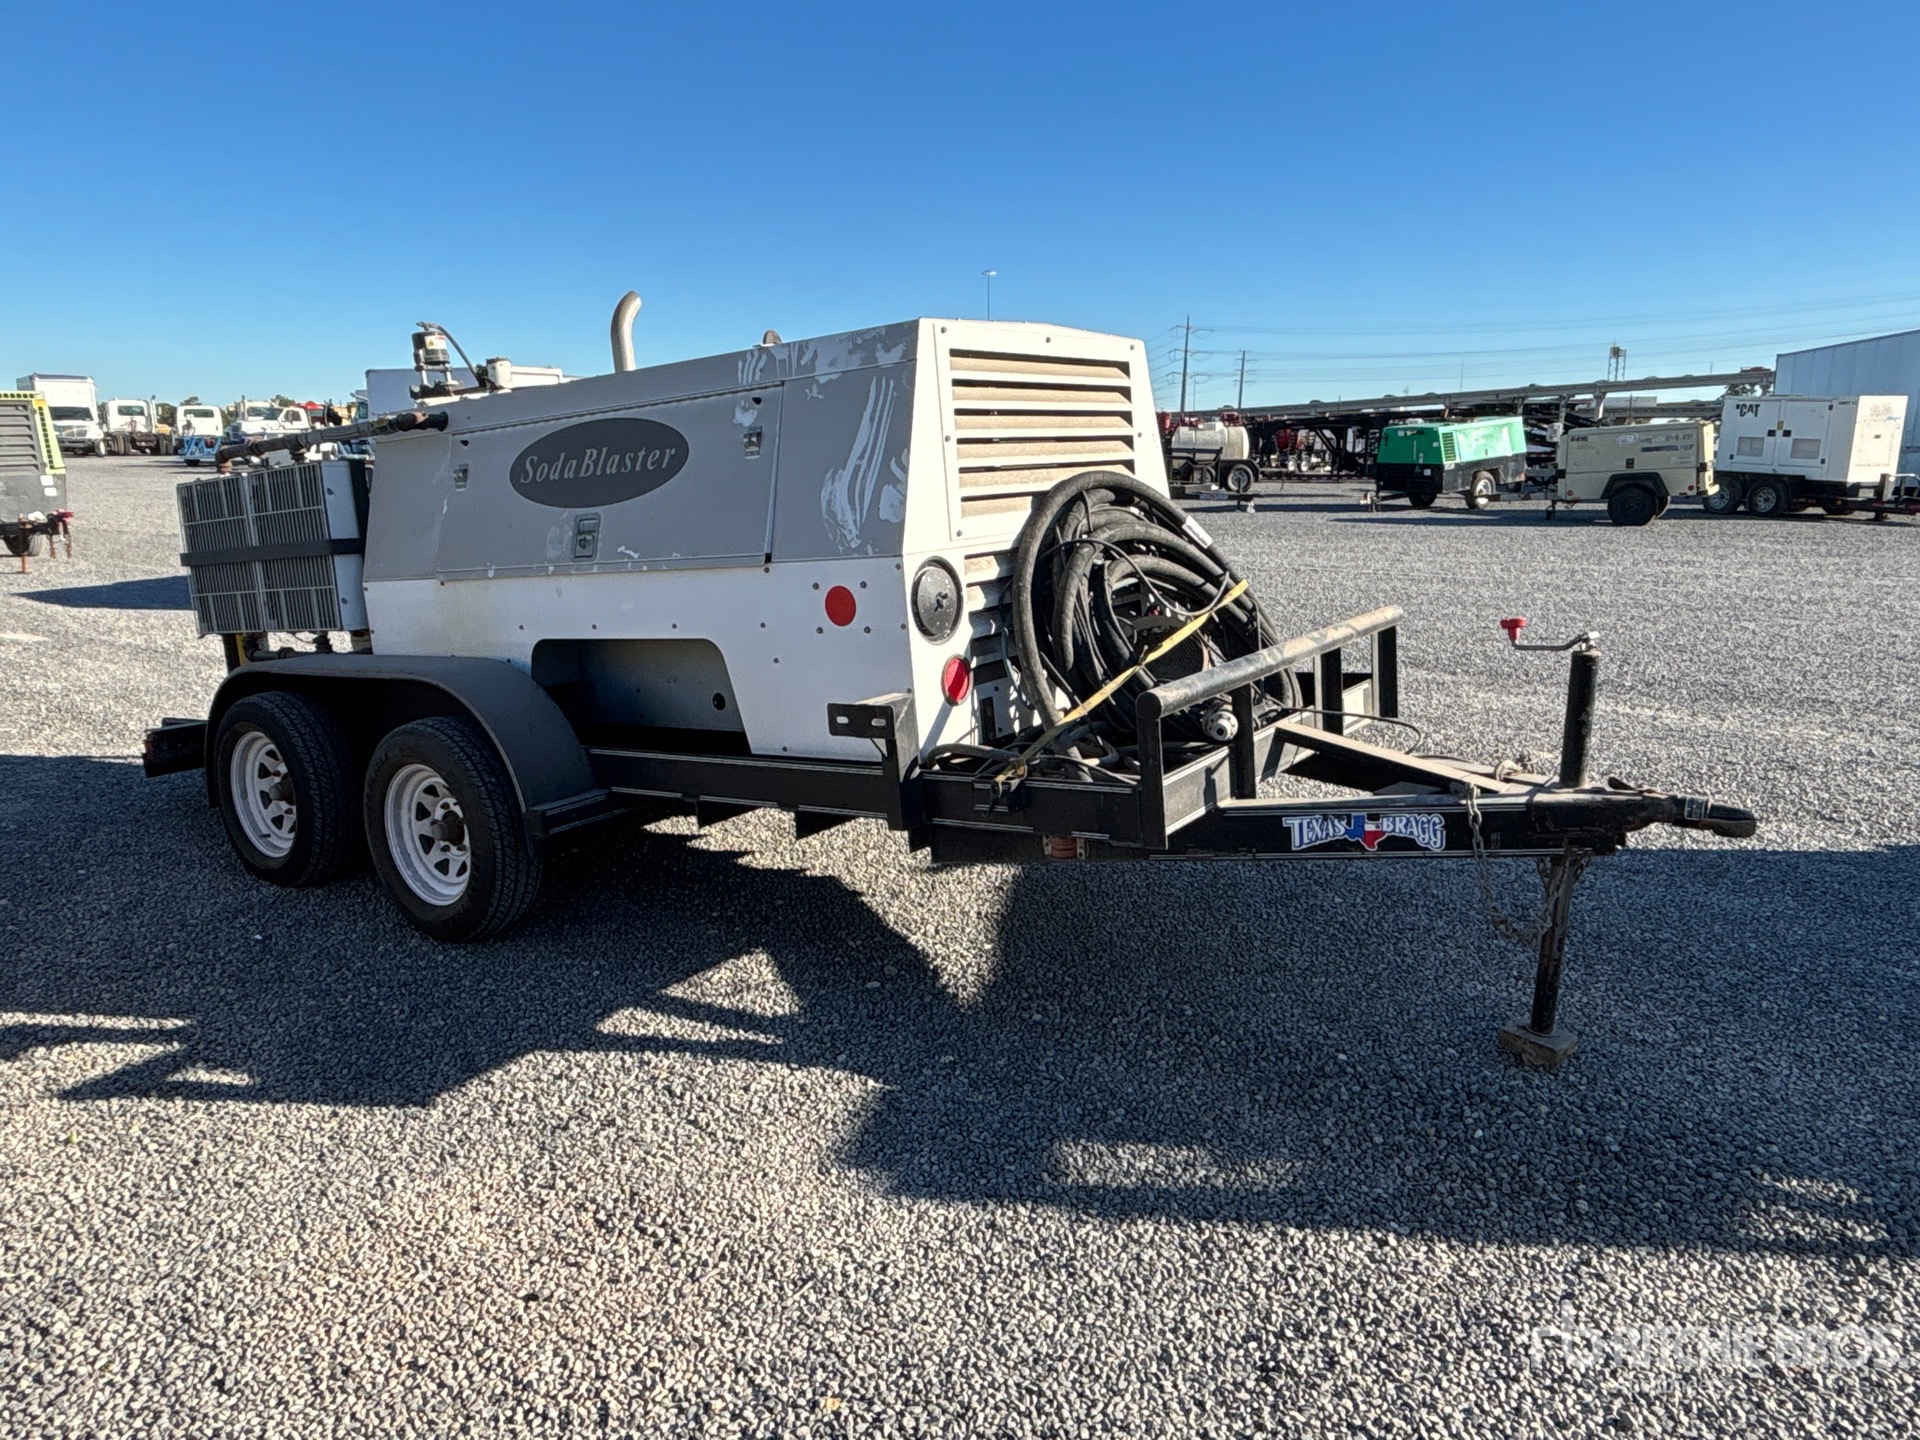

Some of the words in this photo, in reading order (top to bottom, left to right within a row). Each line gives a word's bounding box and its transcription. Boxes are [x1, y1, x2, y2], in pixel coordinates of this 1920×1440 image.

[1739, 404, 1761, 417] CAT
[519, 446, 677, 484] SodaBlaster
[1282, 814, 1347, 850] TEXAS
[1382, 814, 1445, 850] BRAGG
